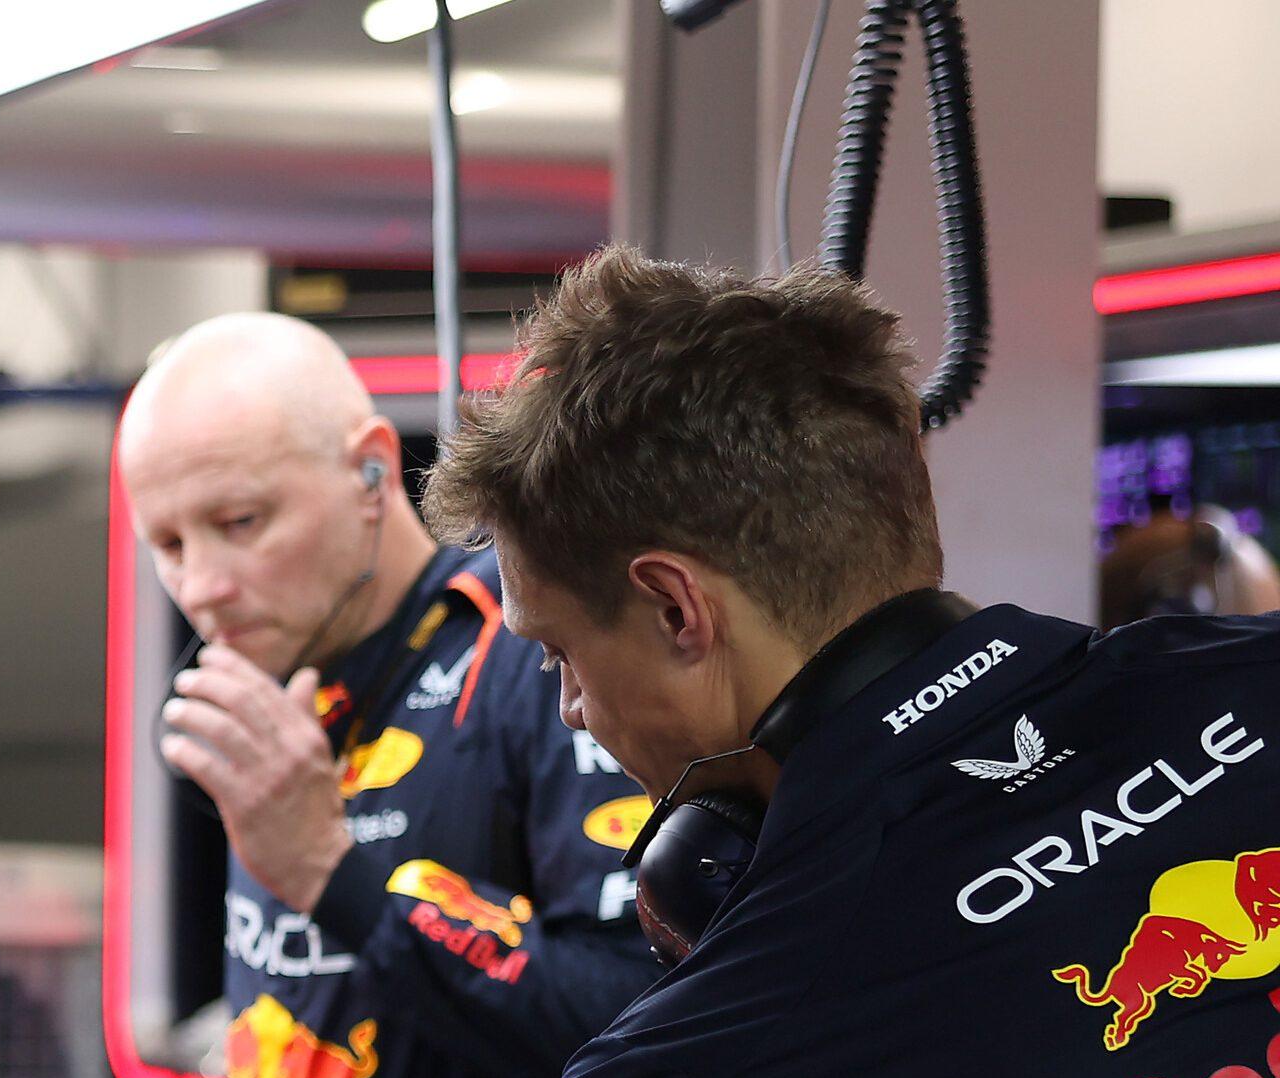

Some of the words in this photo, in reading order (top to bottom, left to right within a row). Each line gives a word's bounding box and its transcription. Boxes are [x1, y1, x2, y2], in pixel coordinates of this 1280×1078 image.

[882, 638, 1019, 736] HONDA
[956, 711, 1266, 924] ORACLE
[1003, 748, 1077, 793] CASTORE
